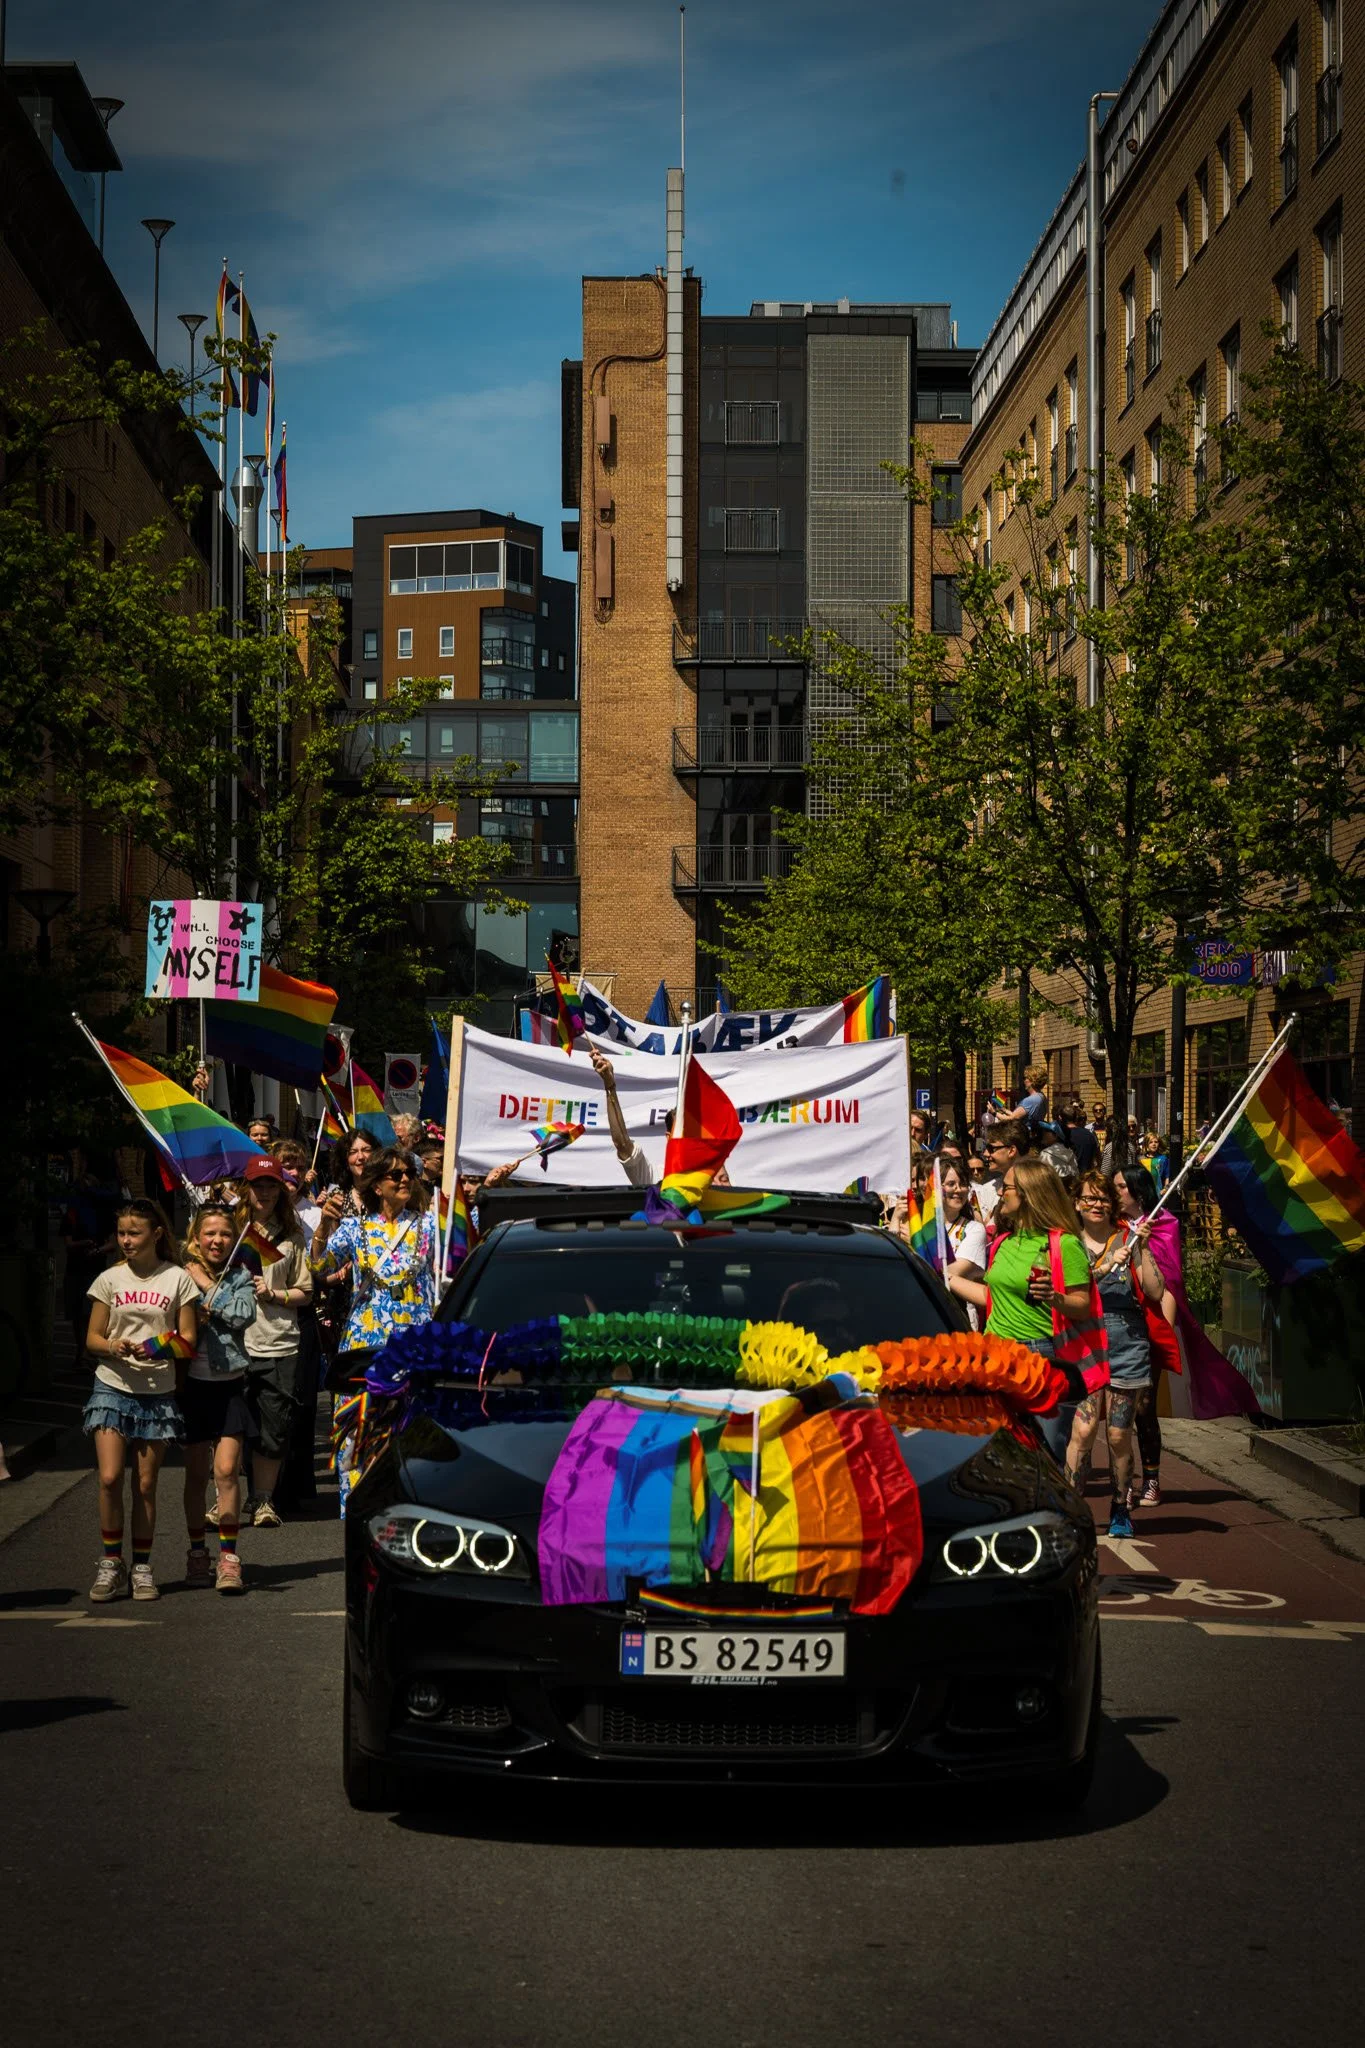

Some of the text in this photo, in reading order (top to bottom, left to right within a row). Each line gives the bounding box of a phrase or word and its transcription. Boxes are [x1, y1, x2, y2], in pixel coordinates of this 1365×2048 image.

[180, 923, 210, 933] WILL
[205, 935, 255, 950] CHOOSE
[162, 946, 261, 991] MYSELF
[921, 1092, 930, 1107] P
[499, 1094, 598, 1125] DETTE
[738, 1099, 859, 1123] BÆRUM
[113, 1291, 171, 1312] AMOUR
[628, 1657, 638, 1667] N
[654, 1636, 833, 1672] BS 82549
